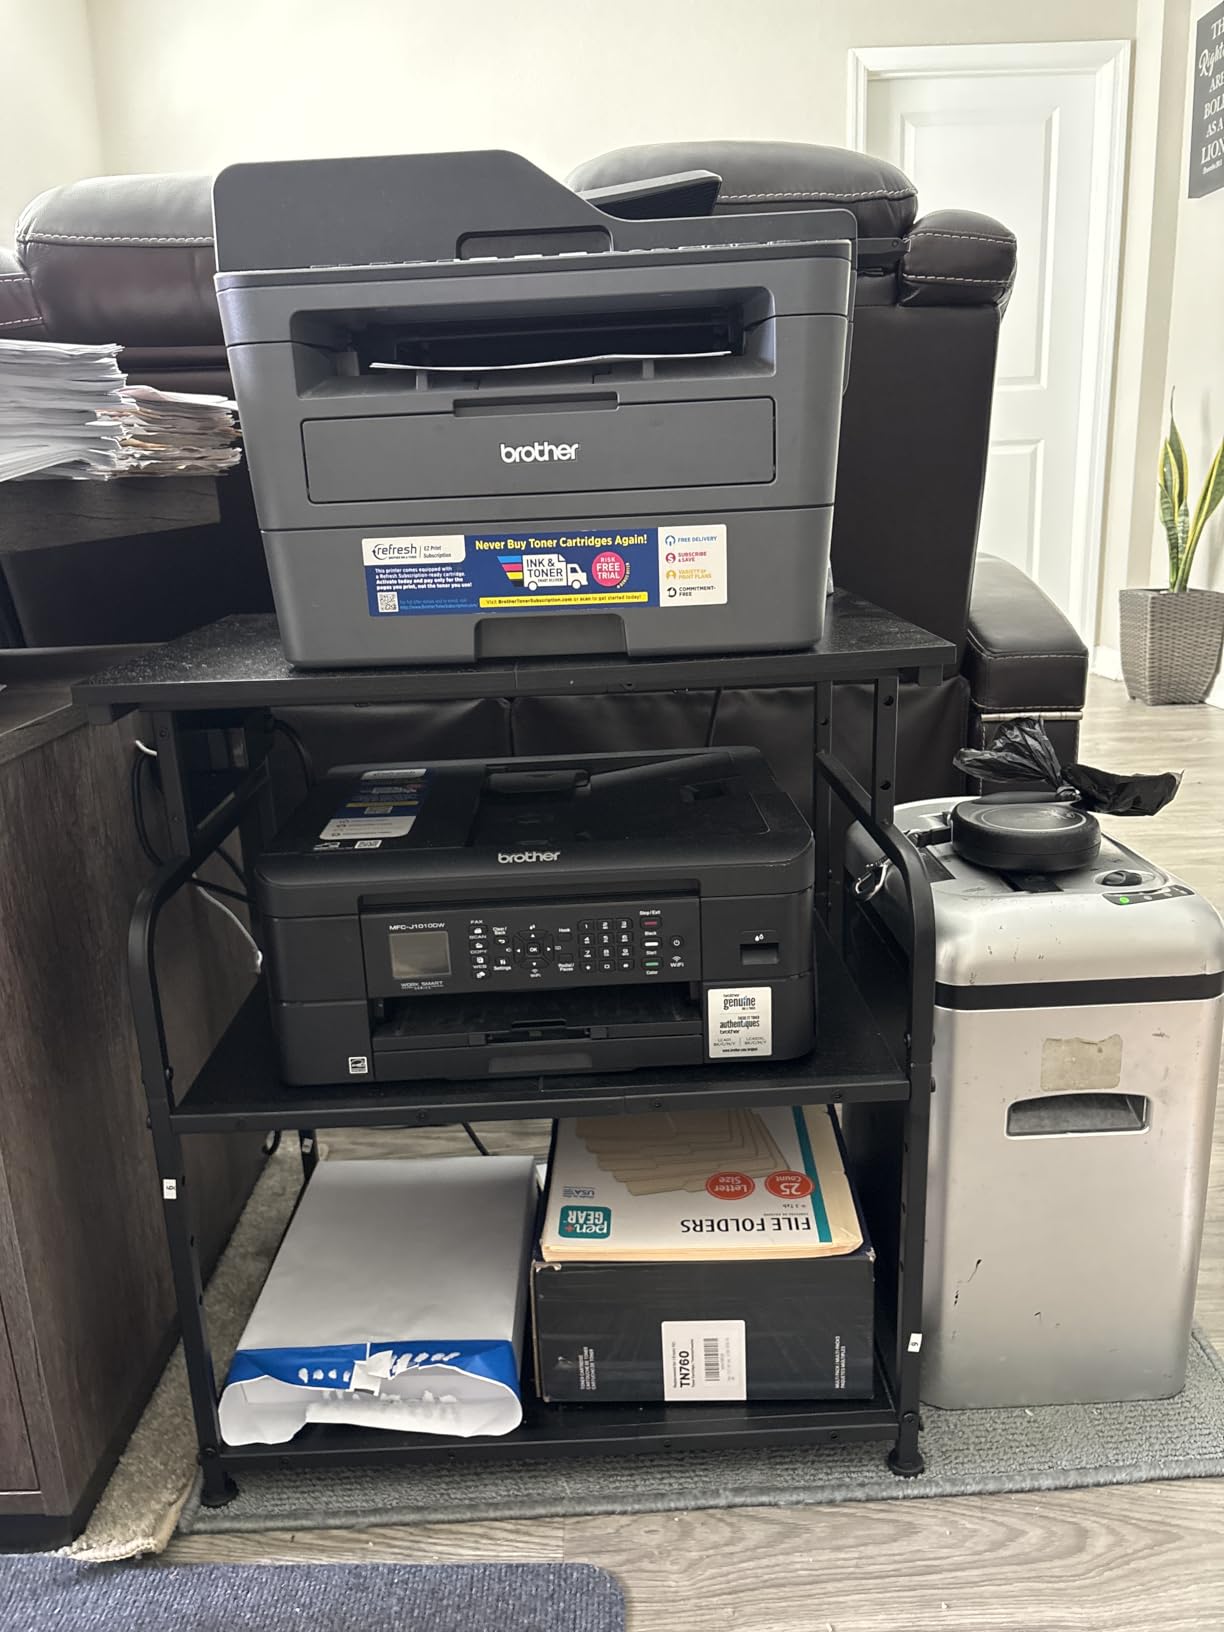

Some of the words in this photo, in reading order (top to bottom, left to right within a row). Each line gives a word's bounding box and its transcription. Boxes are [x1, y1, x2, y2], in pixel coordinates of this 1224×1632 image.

[1206, 120, 1217, 138] AS
[1217, 117, 1223, 132] A
[500, 442, 578, 464] brother
[475, 540, 505, 550] Never
[507, 539, 526, 550] Buy
[529, 538, 557, 549] Toner
[559, 536, 612, 547] Cartridges
[615, 534, 647, 546] Again!
[377, 544, 417, 556] refresh
[526, 559, 545, 568] INK
[548, 558, 555, 567] &
[597, 563, 620, 571] FREE
[528, 568, 563, 578] TONER
[498, 850, 561, 864] brother
[723, 997, 756, 1010] genuine
[719, 1176, 741, 1184] Size
[714, 1184, 748, 1192] Letter
[780, 1182, 801, 1195] 25
[568, 1210, 603, 1224] GEAR
[680, 1218, 765, 1233] FOLDERS
[770, 1217, 811, 1231] FILE
[679, 1351, 690, 1388] TN760
